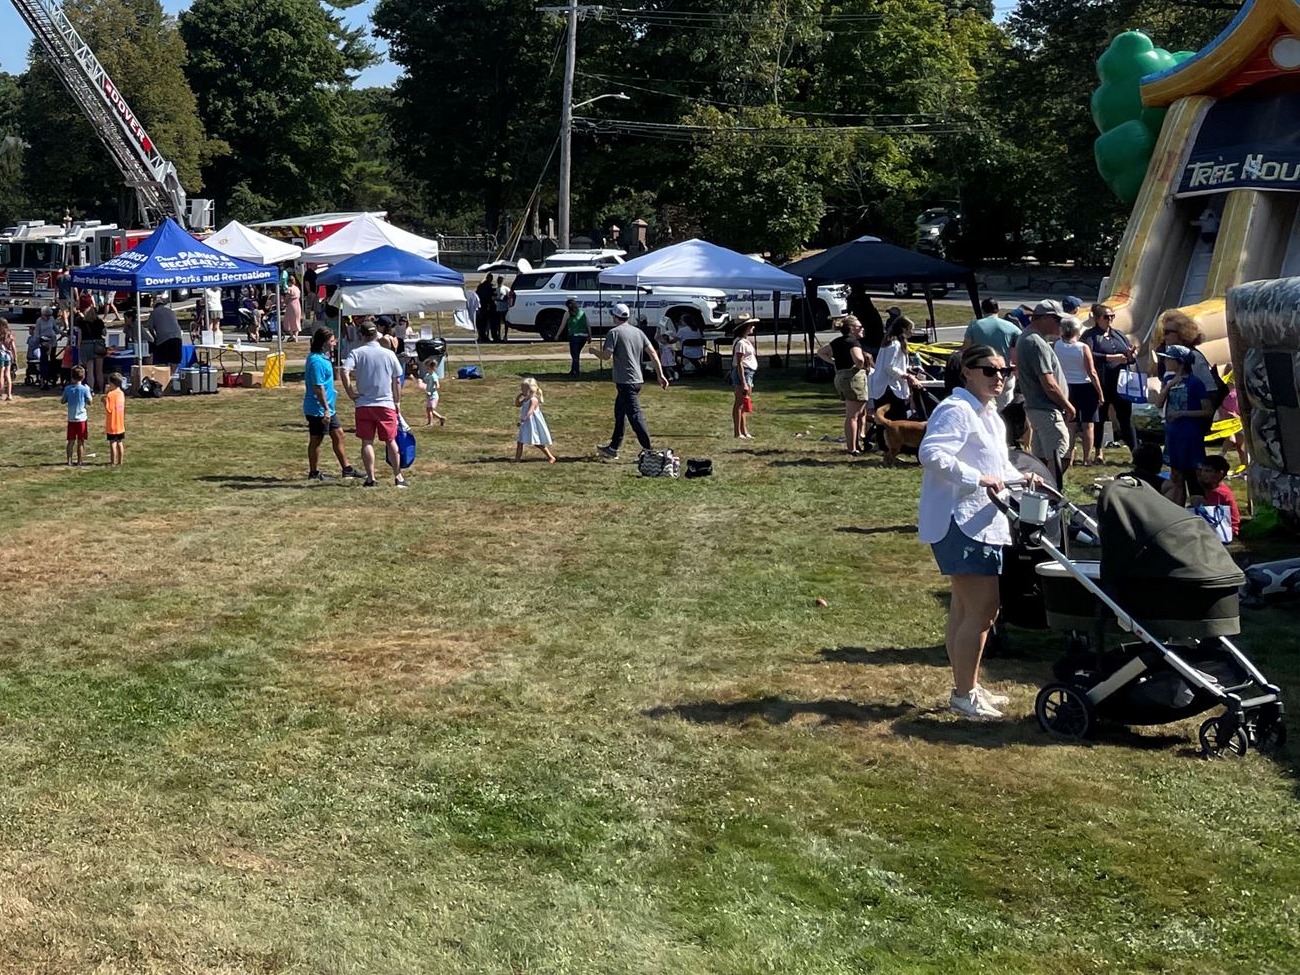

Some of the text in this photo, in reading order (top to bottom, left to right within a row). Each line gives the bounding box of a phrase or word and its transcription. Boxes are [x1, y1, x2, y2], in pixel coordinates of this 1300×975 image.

[111, 89, 145, 142] DOVER
[1187, 161, 1240, 187] TREE
[178, 251, 219, 261] PARKS
[175, 275, 201, 284] Parks
[203, 273, 219, 281] and
[222, 271, 270, 281] Recreation
